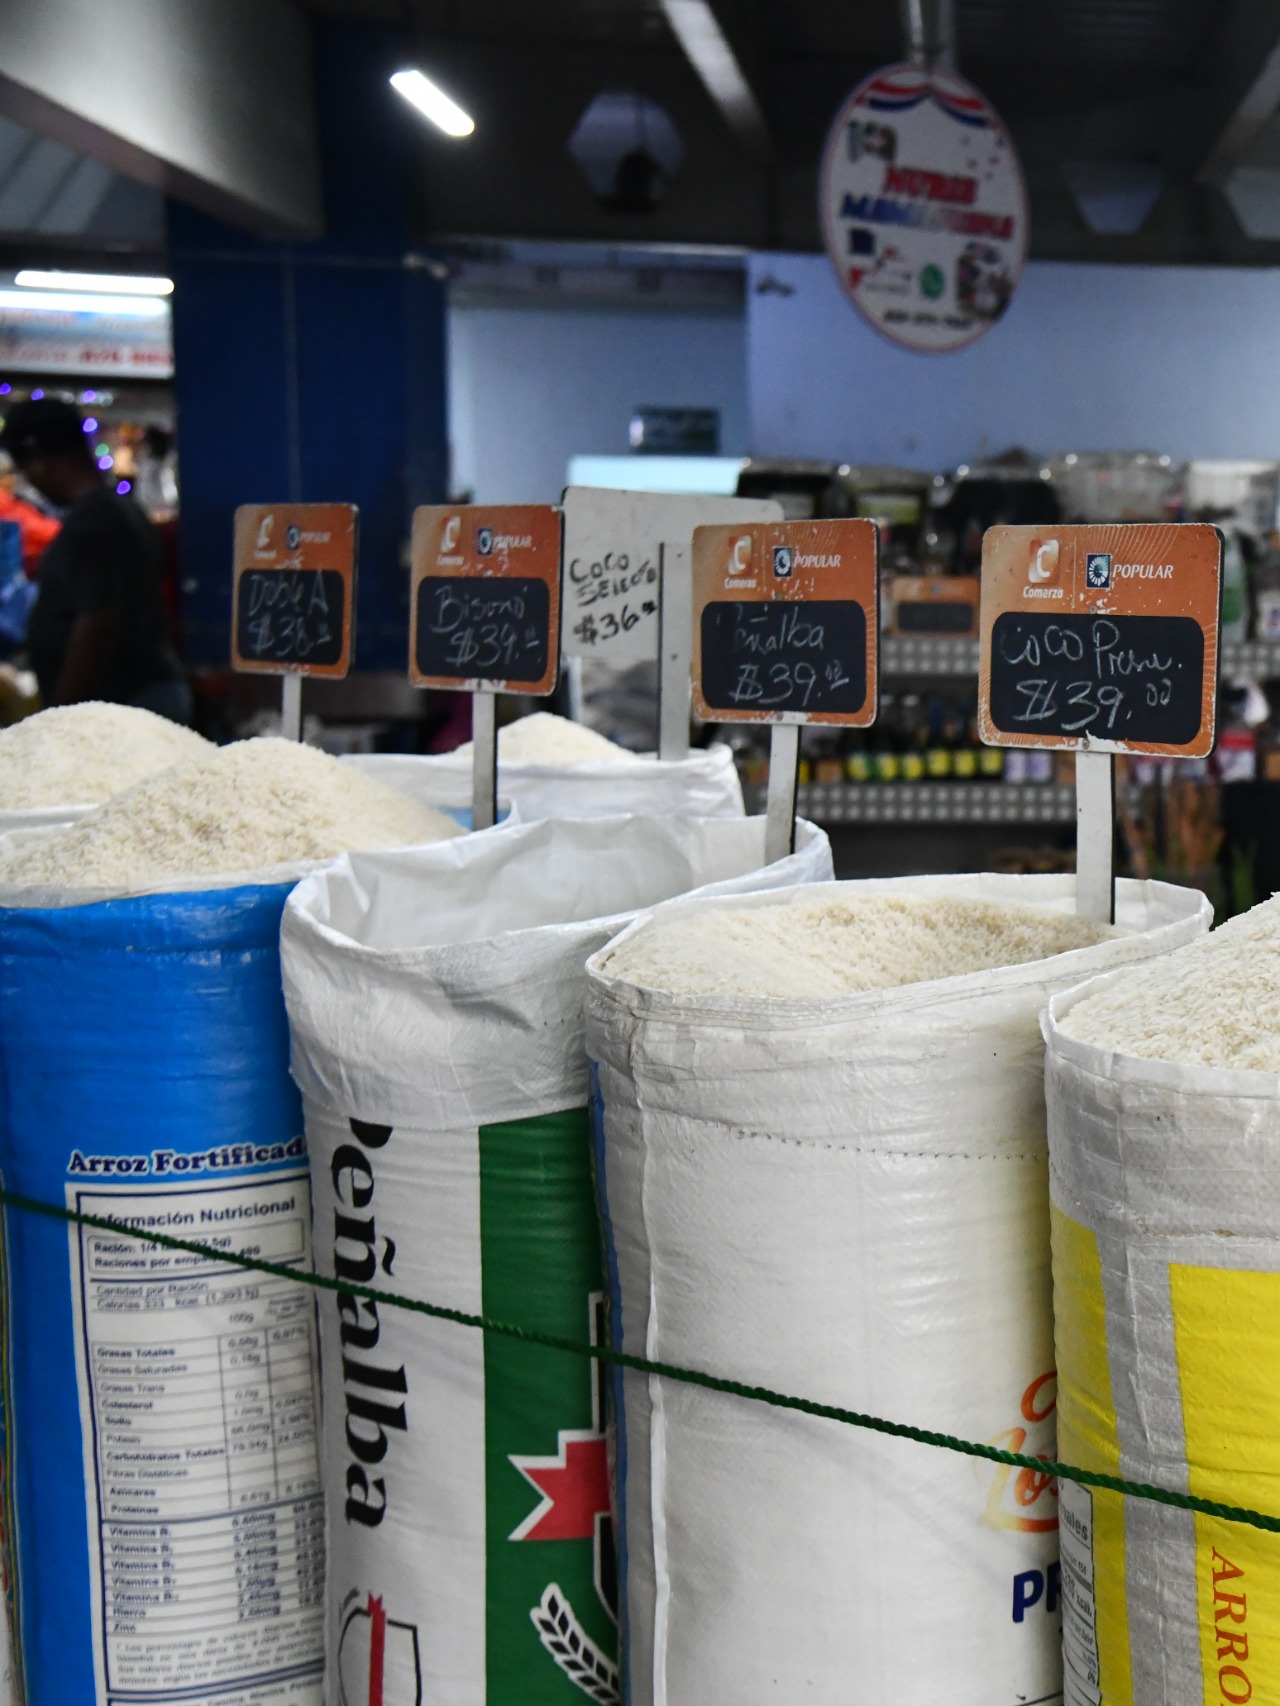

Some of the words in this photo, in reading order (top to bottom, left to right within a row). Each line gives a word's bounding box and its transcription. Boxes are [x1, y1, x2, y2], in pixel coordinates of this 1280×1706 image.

[793, 553, 842, 569] POPULAR
[1112, 564, 1174, 579] POPULAR
[1022, 586, 1063, 599] Comerza
[68, 1150, 149, 1176] Arroz
[153, 1135, 307, 1174] Fortificad
[93, 1209, 195, 1228] nformación
[200, 1197, 296, 1223] Nutricional
